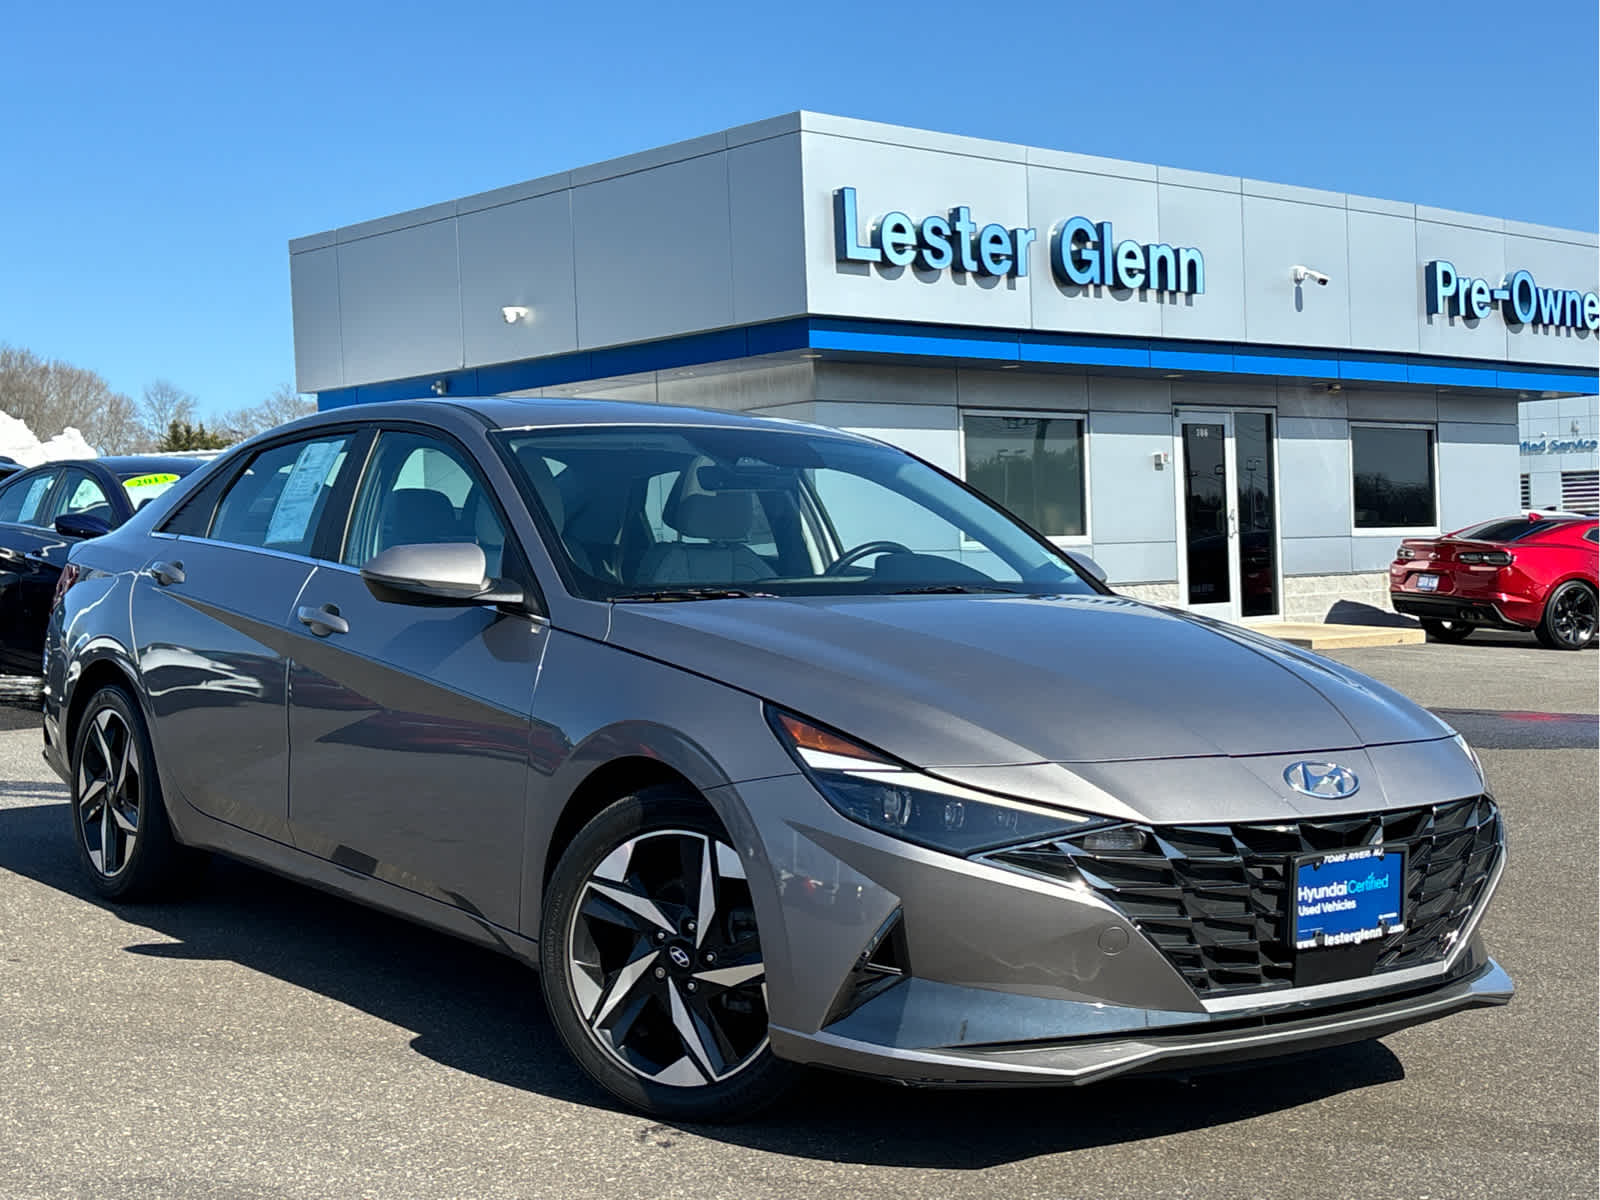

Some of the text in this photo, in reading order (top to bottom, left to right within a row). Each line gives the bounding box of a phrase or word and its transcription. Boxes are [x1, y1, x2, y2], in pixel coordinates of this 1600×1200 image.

[832, 187, 1206, 295] Lester Glenn
[1425, 259, 1599, 330] Pre-Owne
[1548, 440, 1598, 450] Service
[1298, 900, 1357, 917] Used Vehicles
[1324, 928, 1383, 947] lesterglenn
